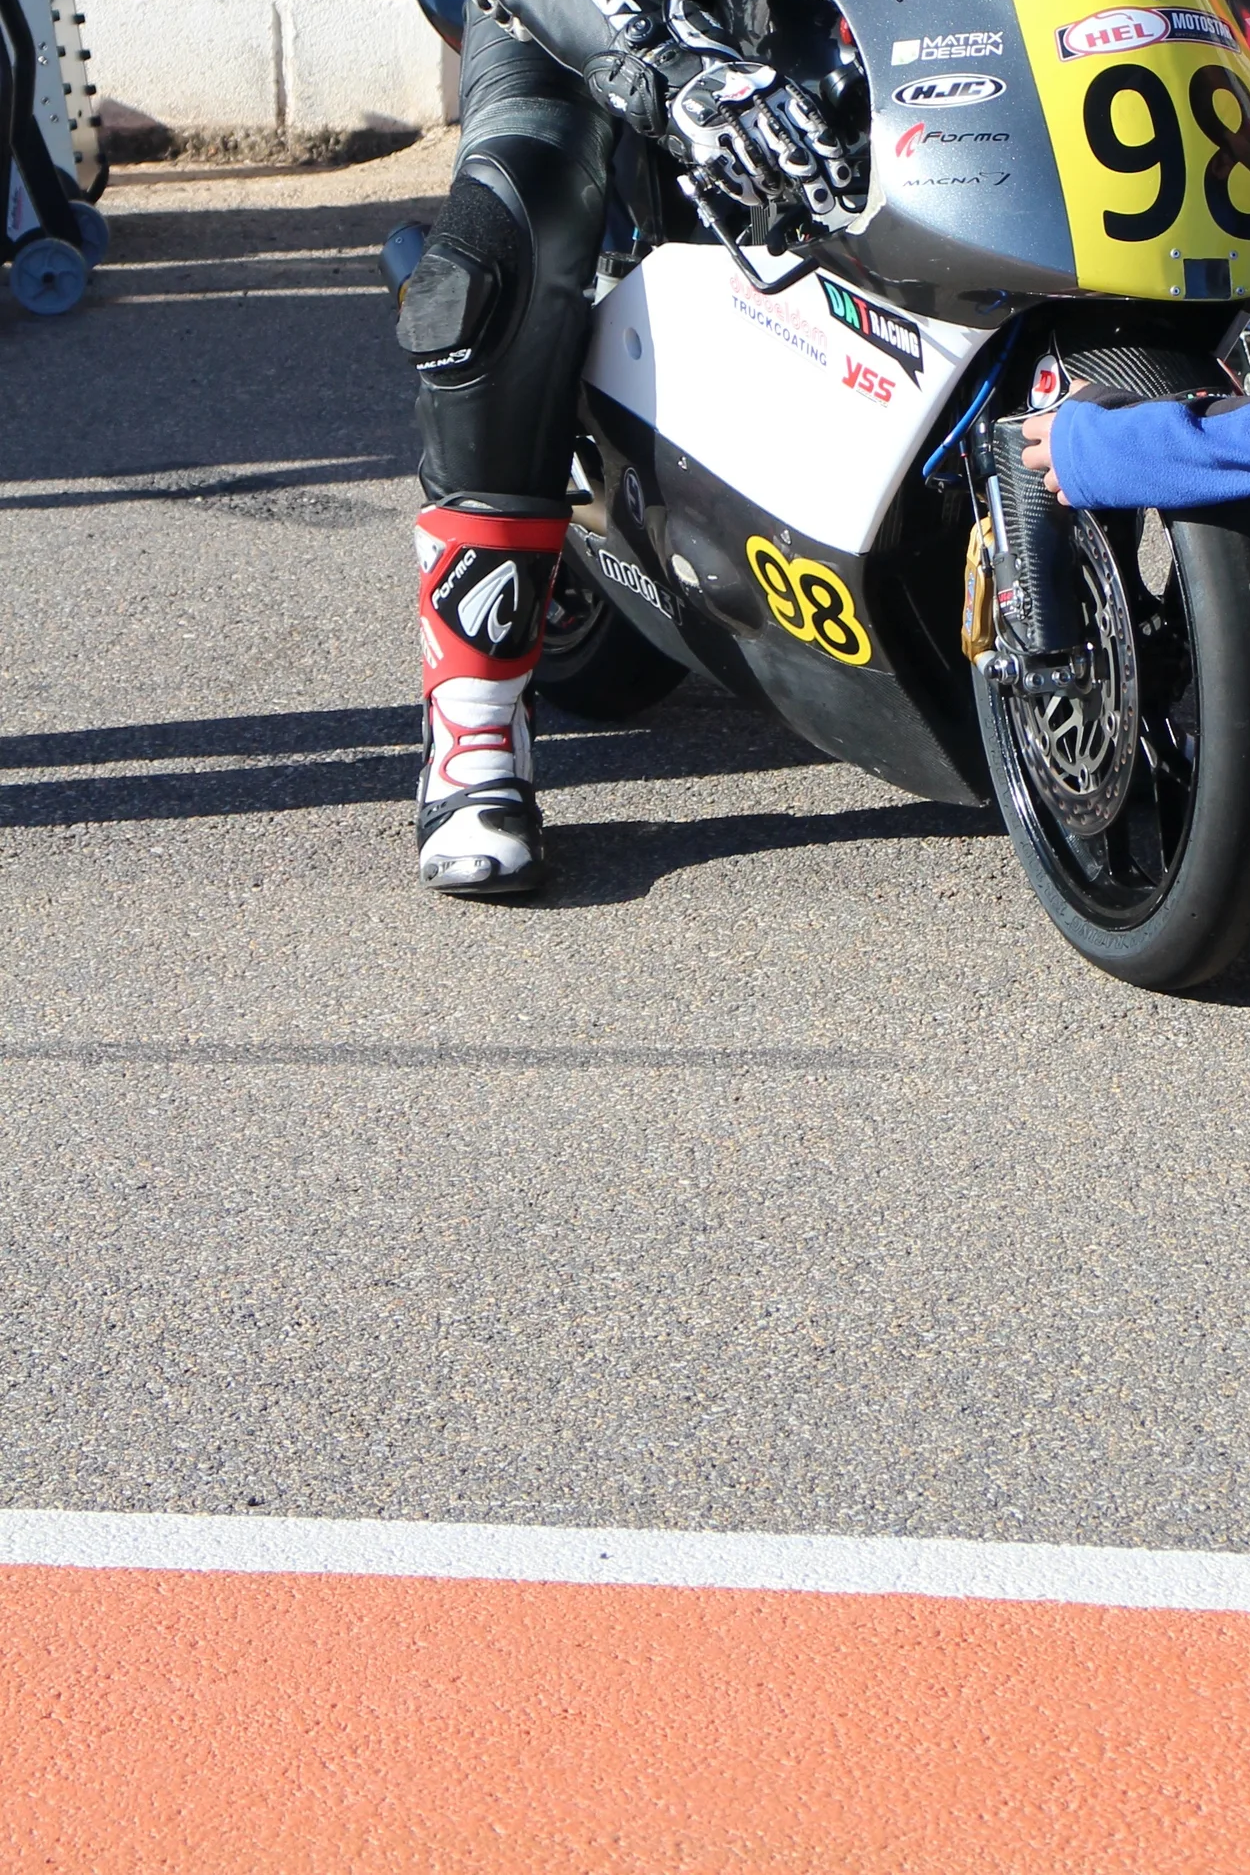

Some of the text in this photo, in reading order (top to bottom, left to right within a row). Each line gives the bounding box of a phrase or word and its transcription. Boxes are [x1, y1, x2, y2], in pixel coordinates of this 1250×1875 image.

[922, 31, 1003, 48] MATRIX
[1084, 23, 1155, 49] HEL
[921, 44, 1003, 61] DESIGN
[910, 80, 986, 101] HJC
[922, 130, 1010, 144] Forma
[902, 176, 981, 188] MACNA
[732, 294, 828, 367] TRUCKCOATING
[823, 280, 920, 359] DAT RACING
[431, 548, 477, 611] Forma
[754, 549, 861, 656] 98
